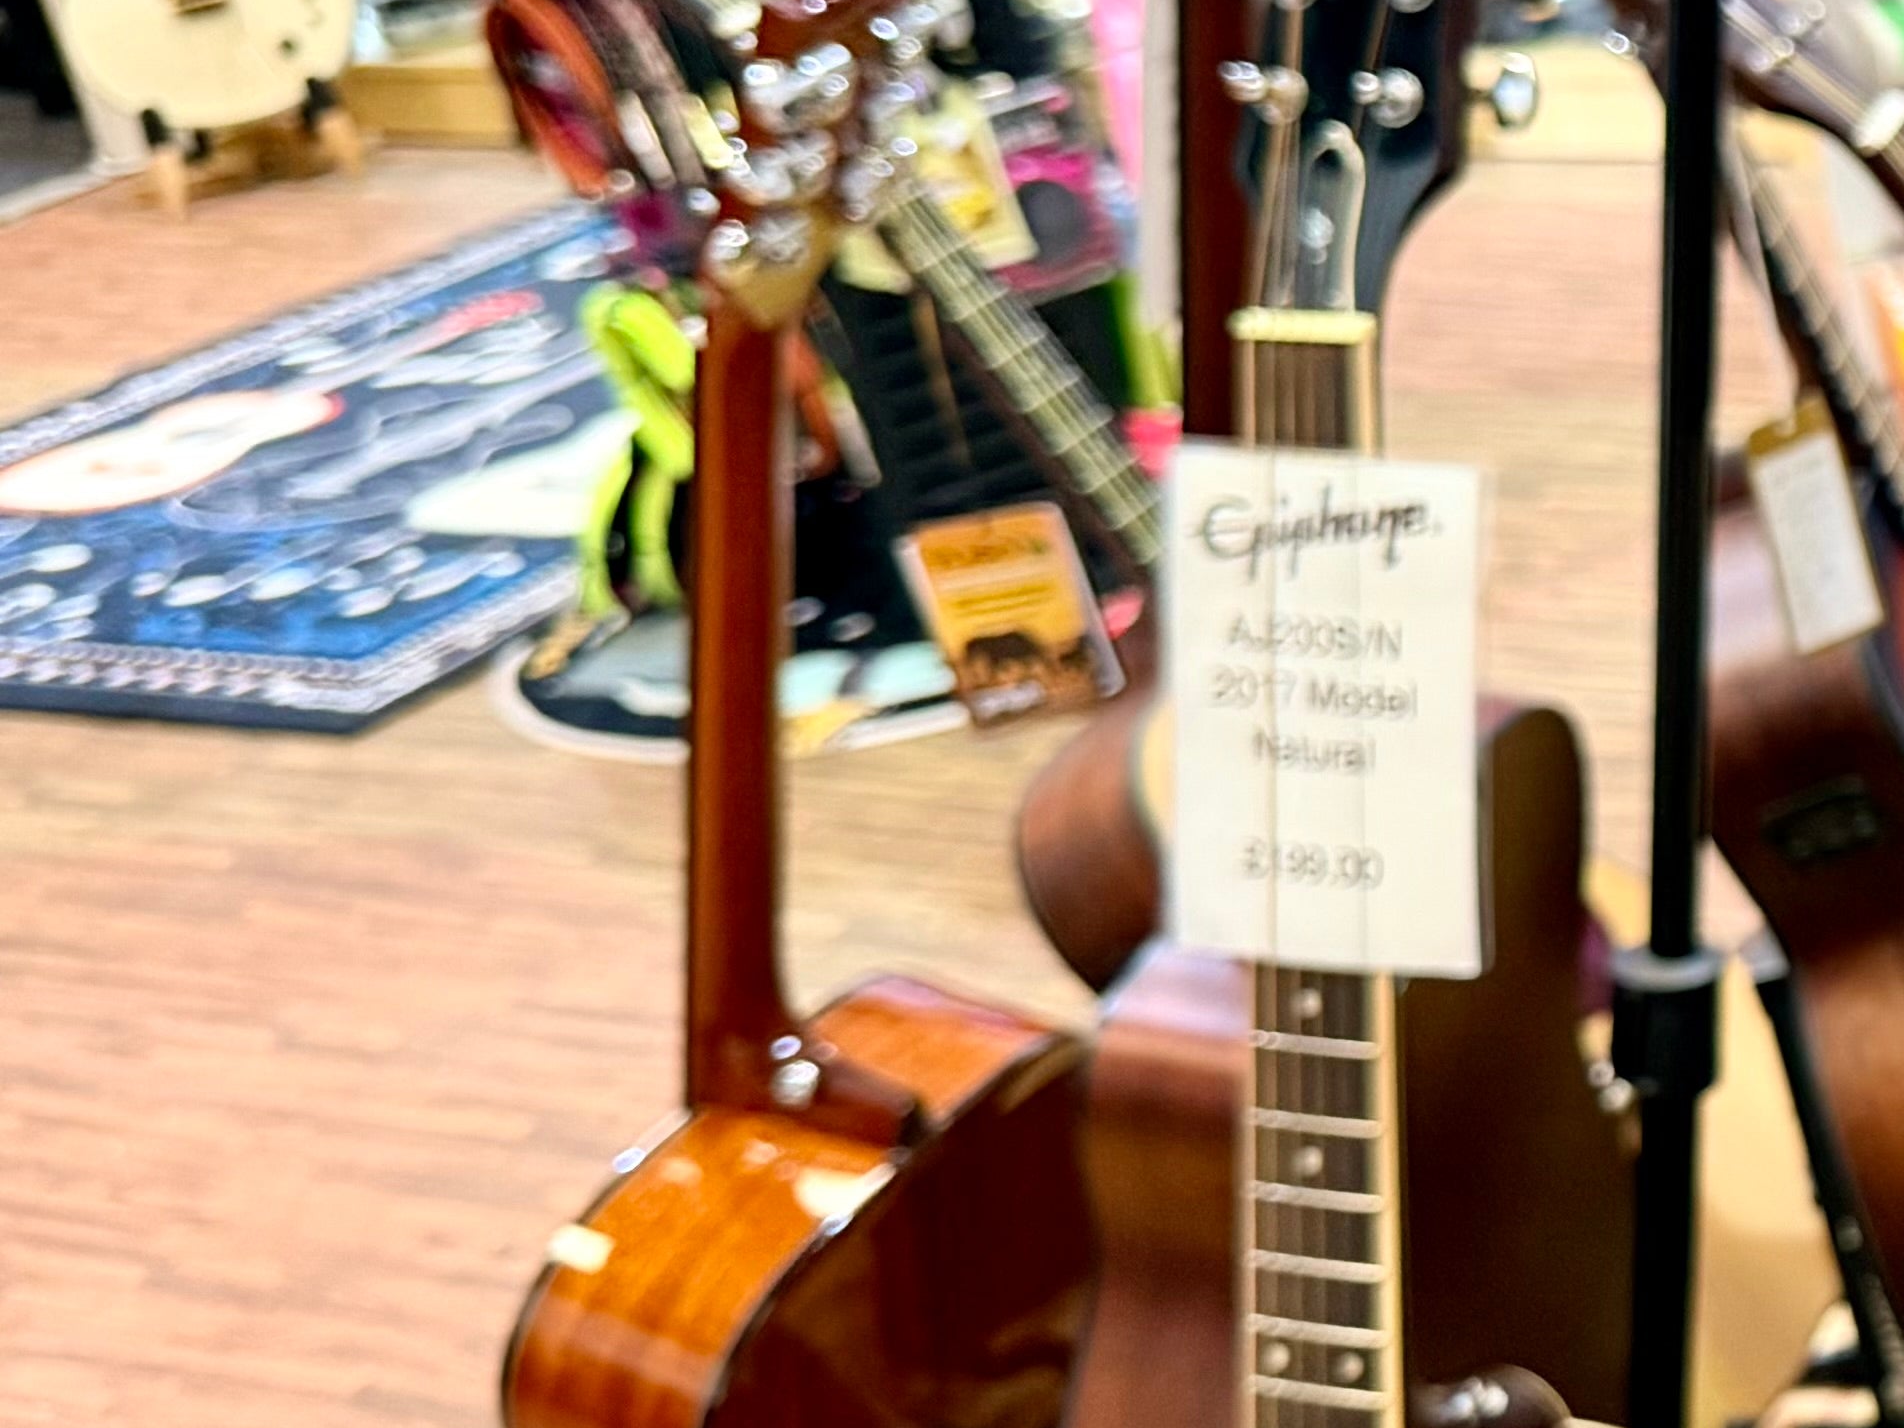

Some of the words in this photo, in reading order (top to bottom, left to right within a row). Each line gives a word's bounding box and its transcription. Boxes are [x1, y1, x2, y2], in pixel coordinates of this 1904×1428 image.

[1190, 484, 1430, 583] Epiphone
[1306, 673, 1418, 722] Model
[1251, 727, 1377, 776] Natural
